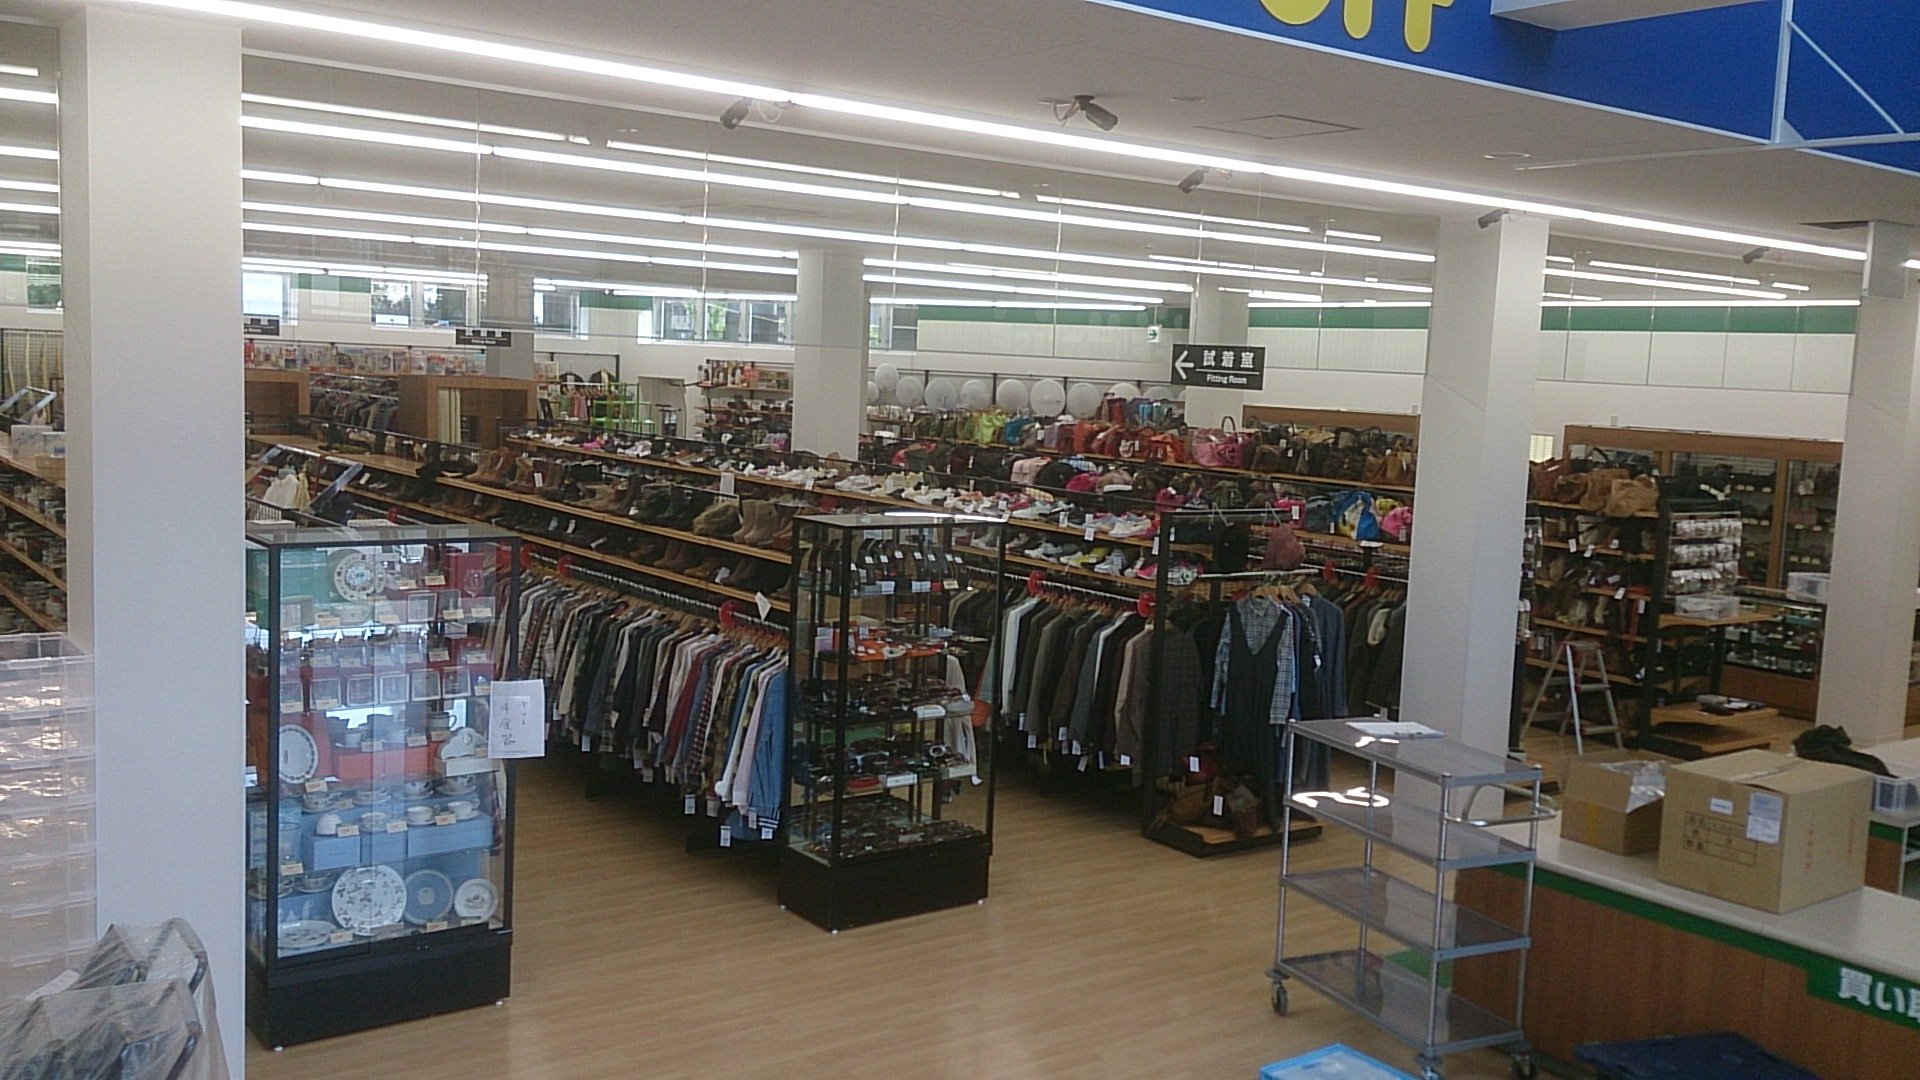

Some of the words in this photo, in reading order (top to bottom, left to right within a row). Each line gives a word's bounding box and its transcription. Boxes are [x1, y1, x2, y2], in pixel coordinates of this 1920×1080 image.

[1203, 350, 1254, 368] 試着室
[1206, 374, 1228, 384] Fitting
[1229, 375, 1248, 385] Room
